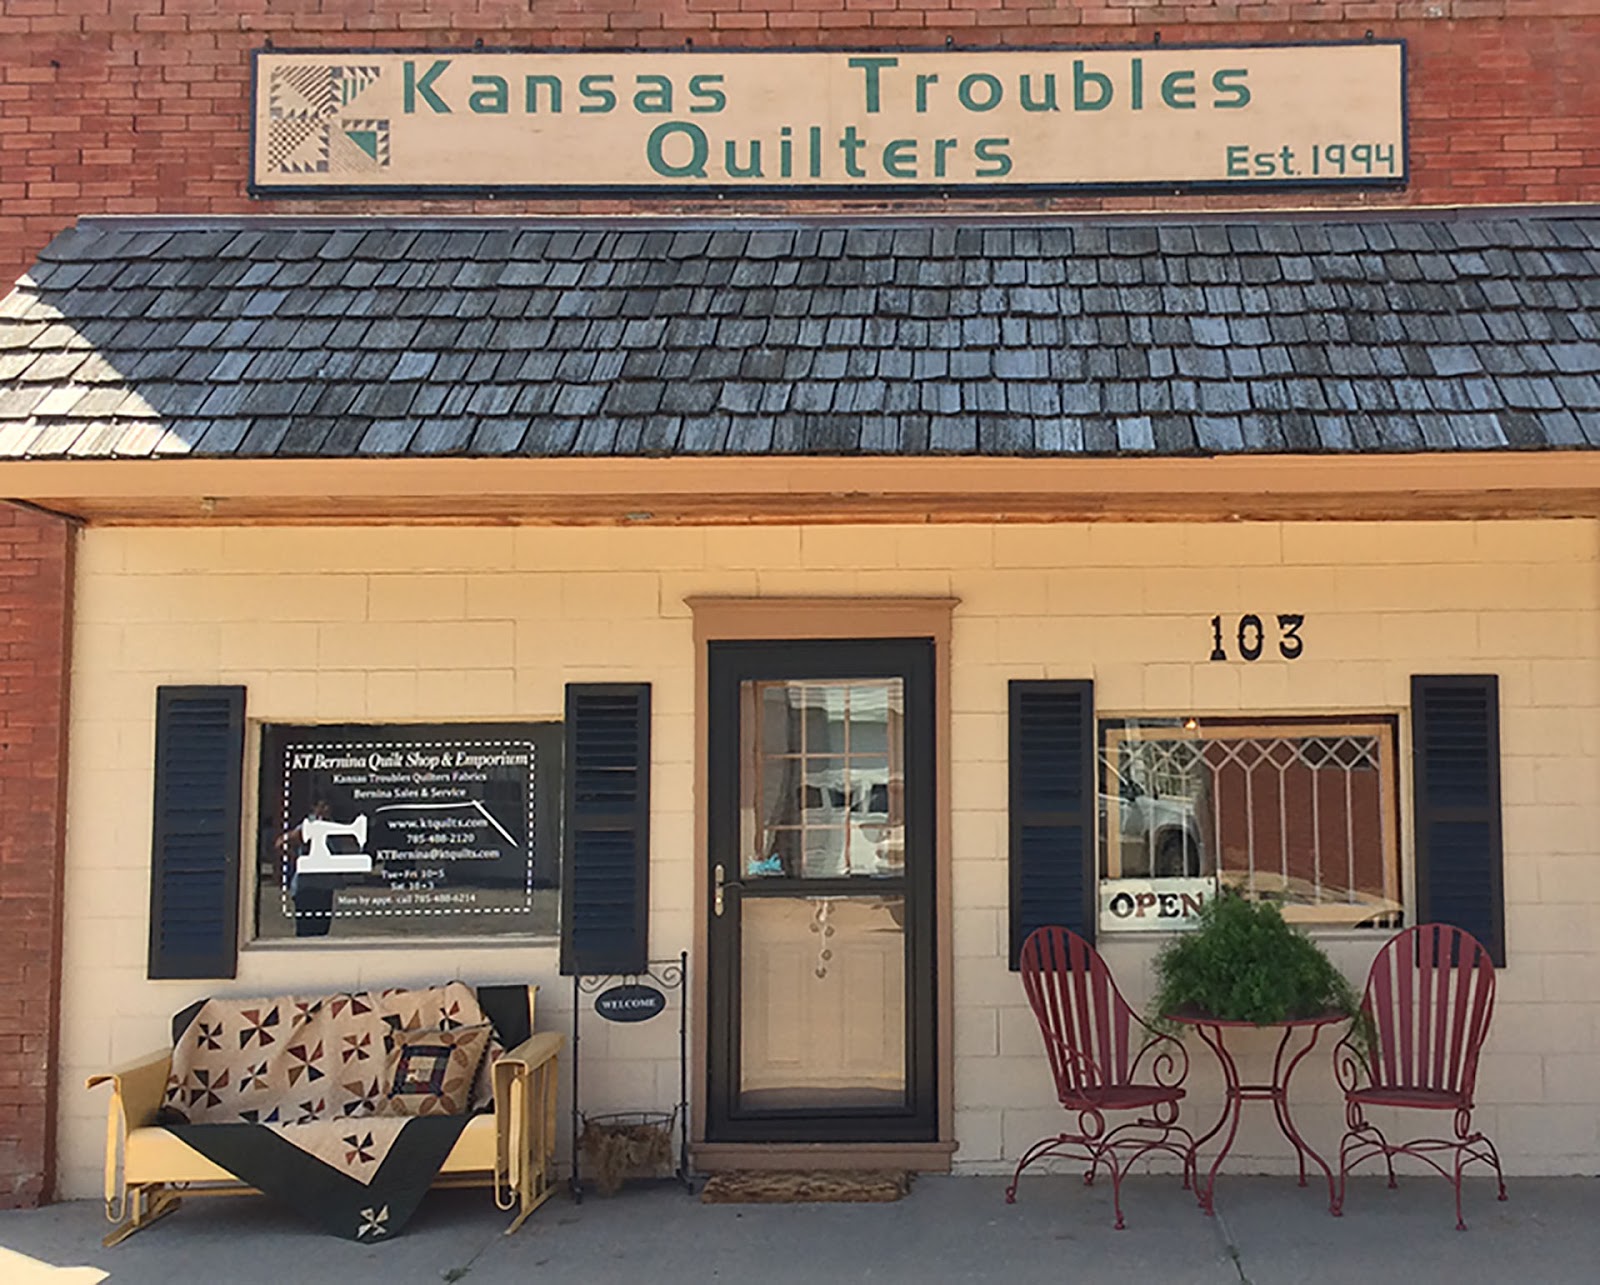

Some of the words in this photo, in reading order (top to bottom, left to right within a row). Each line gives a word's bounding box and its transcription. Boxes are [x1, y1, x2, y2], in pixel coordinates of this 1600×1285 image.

[402, 59, 727, 115] Kansas
[848, 56, 1252, 114] Troubles
[646, 120, 1013, 179] Quilters
[1226, 145, 1301, 177] Est.
[1312, 143, 1395, 175] 1994
[1209, 613, 1305, 661] 103
[313, 752, 366, 769] Bernina
[404, 751, 440, 770] Shop
[441, 751, 453, 767] &
[455, 750, 528, 769] Emporium
[451, 771, 487, 782] Fabrics
[394, 788, 418, 798] Sales
[430, 787, 466, 798] Service
[1109, 892, 1203, 918] OPEN
[601, 998, 656, 1010] WELCOME
